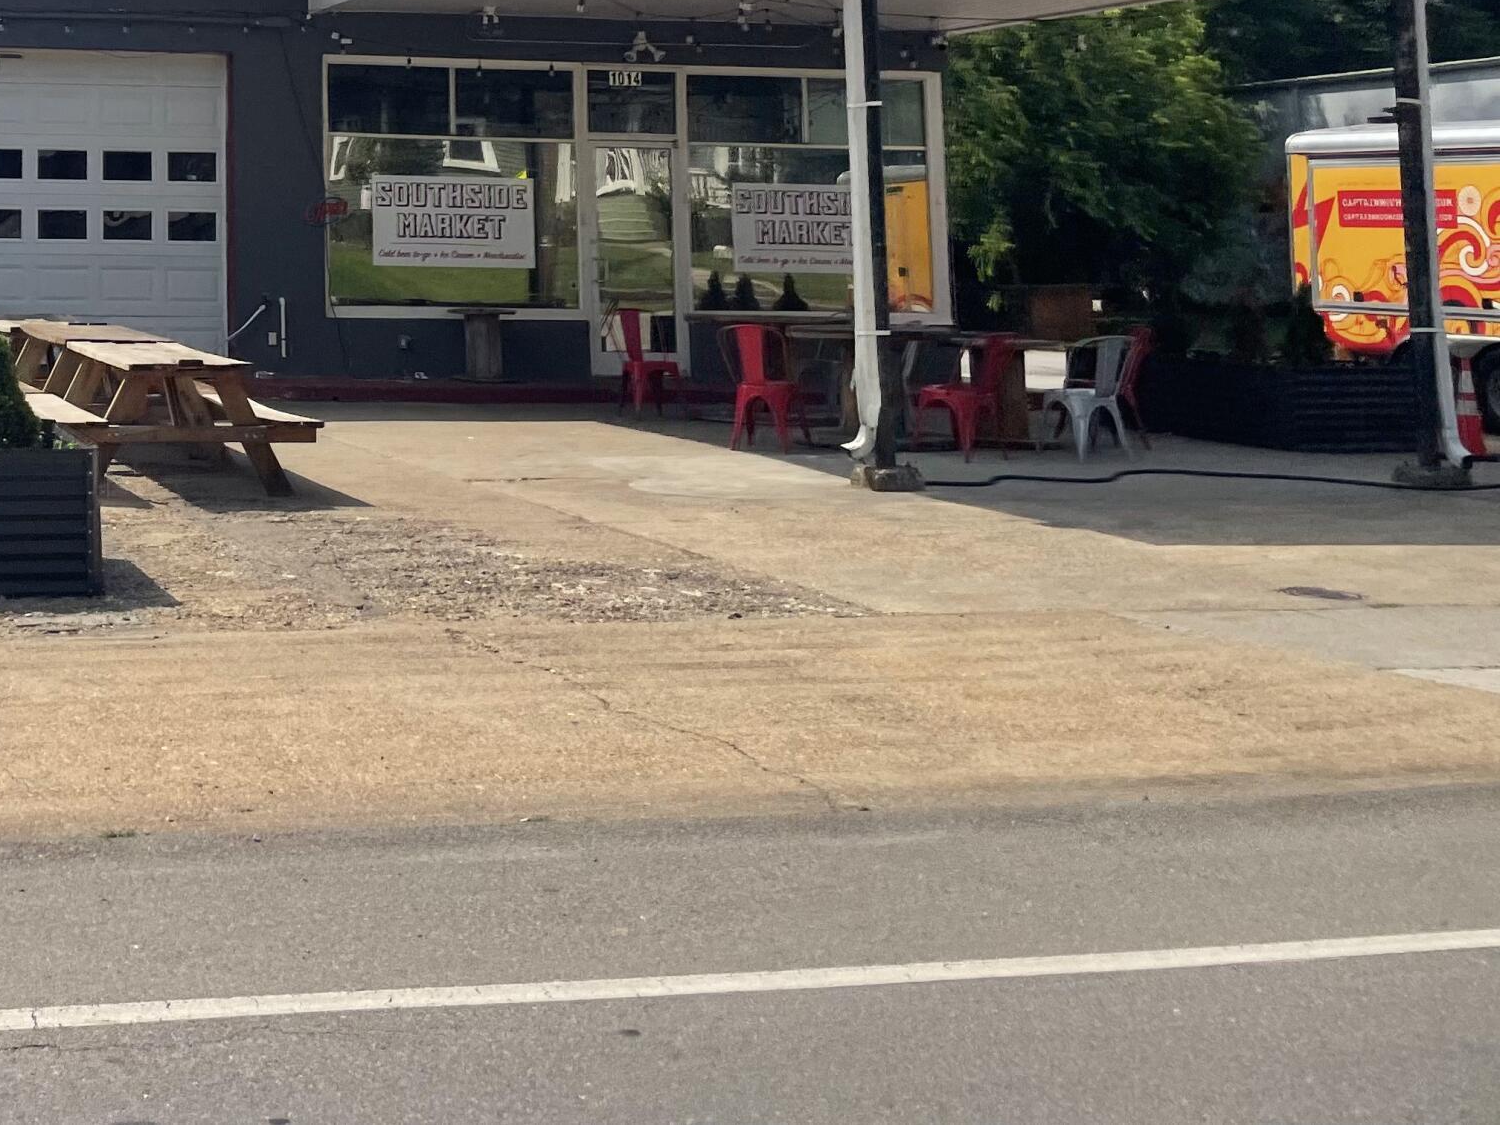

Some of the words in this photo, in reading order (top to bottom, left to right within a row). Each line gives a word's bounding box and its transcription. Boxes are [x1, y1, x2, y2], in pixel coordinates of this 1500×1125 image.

[610, 71, 641, 85] 1014
[375, 181, 528, 210] SOUTHSIDE
[736, 189, 852, 216] SOUTHSI
[397, 212, 506, 240] MARKET
